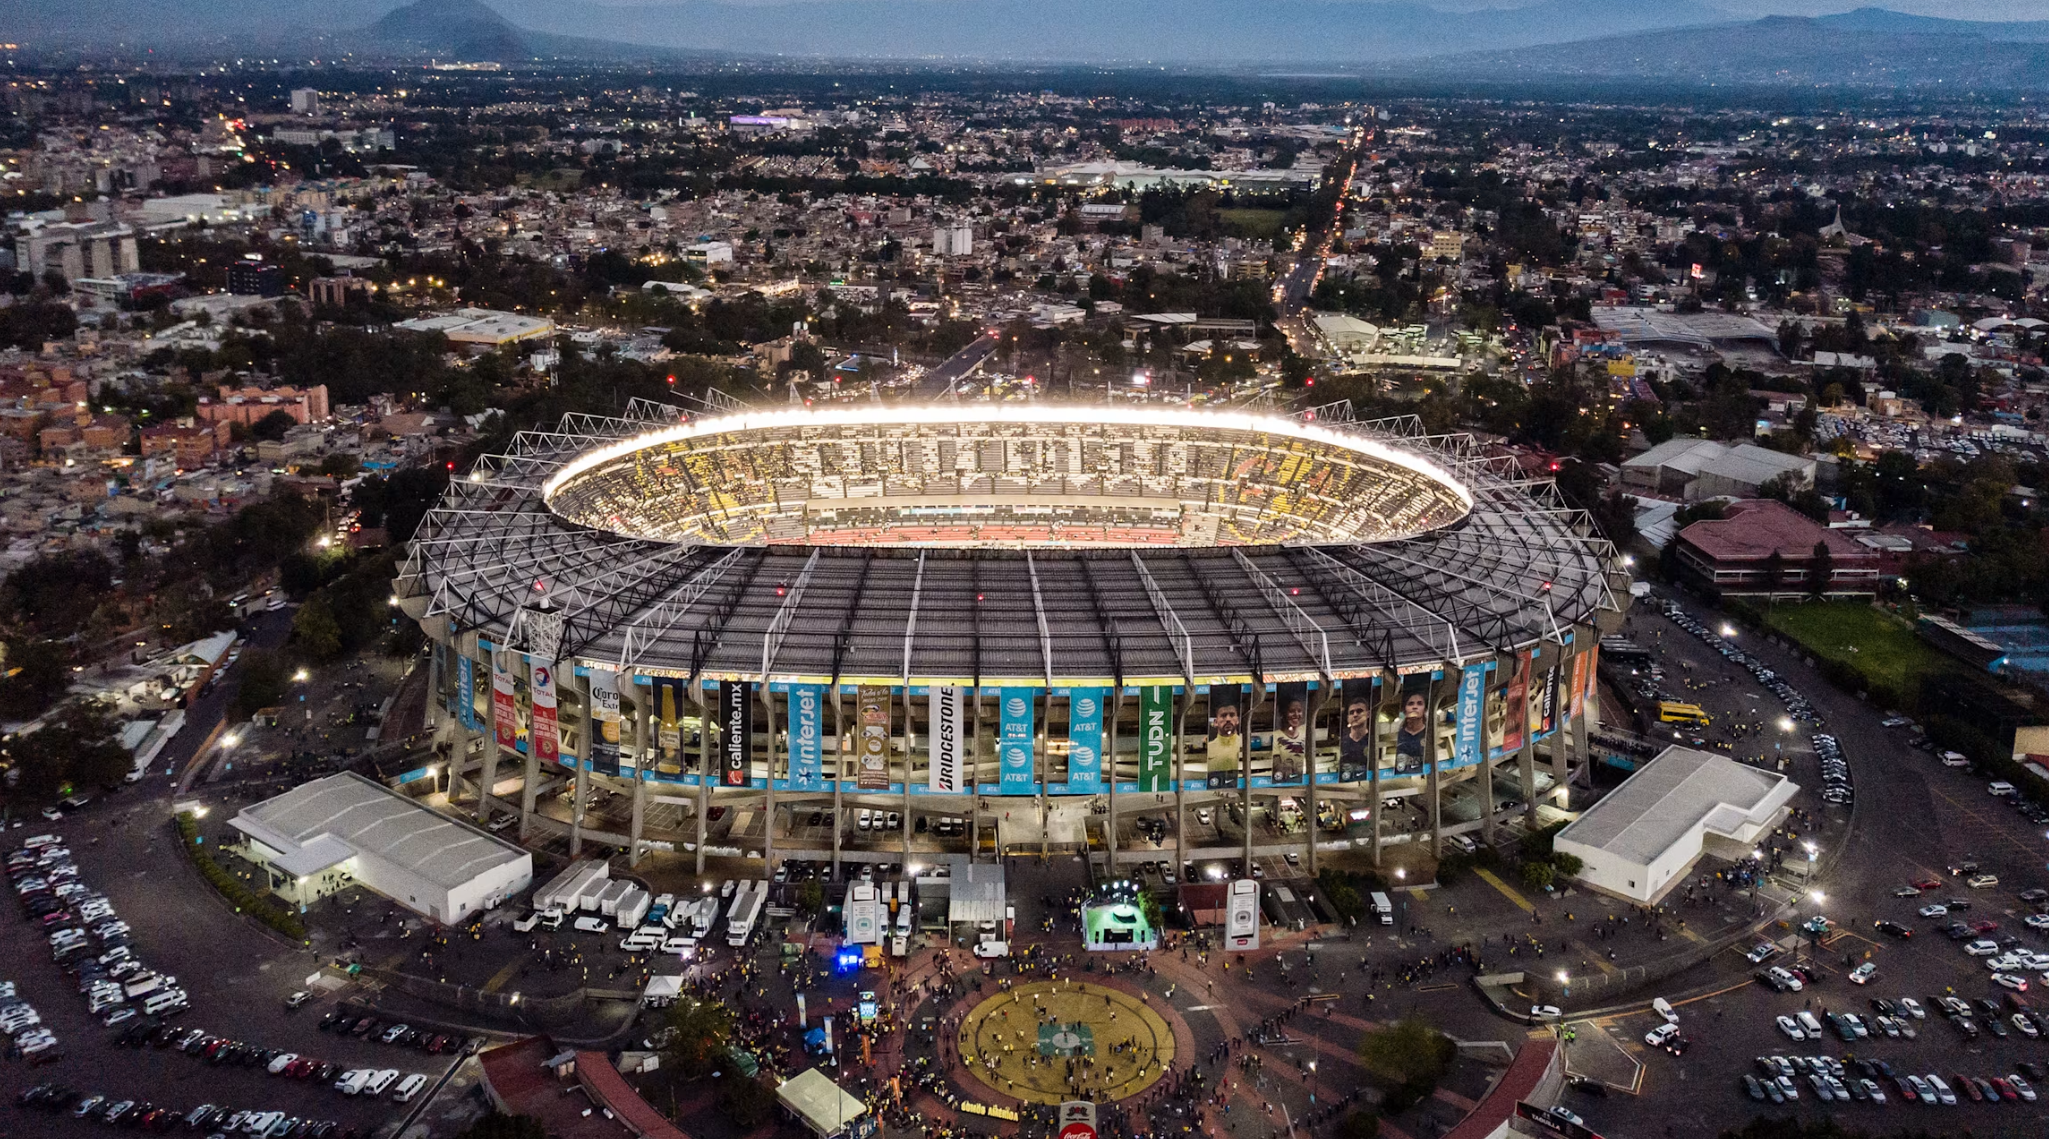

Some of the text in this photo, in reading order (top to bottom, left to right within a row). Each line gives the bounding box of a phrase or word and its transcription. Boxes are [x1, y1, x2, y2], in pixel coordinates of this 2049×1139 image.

[533, 687, 554, 698] TOTAL
[592, 686, 619, 701] Coro
[728, 683, 742, 769] caliente.mx
[1005, 723, 1028, 733] AT&T
[1074, 722, 1097, 732] AT&T
[939, 687, 954, 791] BRIDGESTONE
[1148, 711, 1164, 771] TUDN
[1004, 773, 1028, 783] AT&T
[1072, 772, 1096, 781] AT&T
